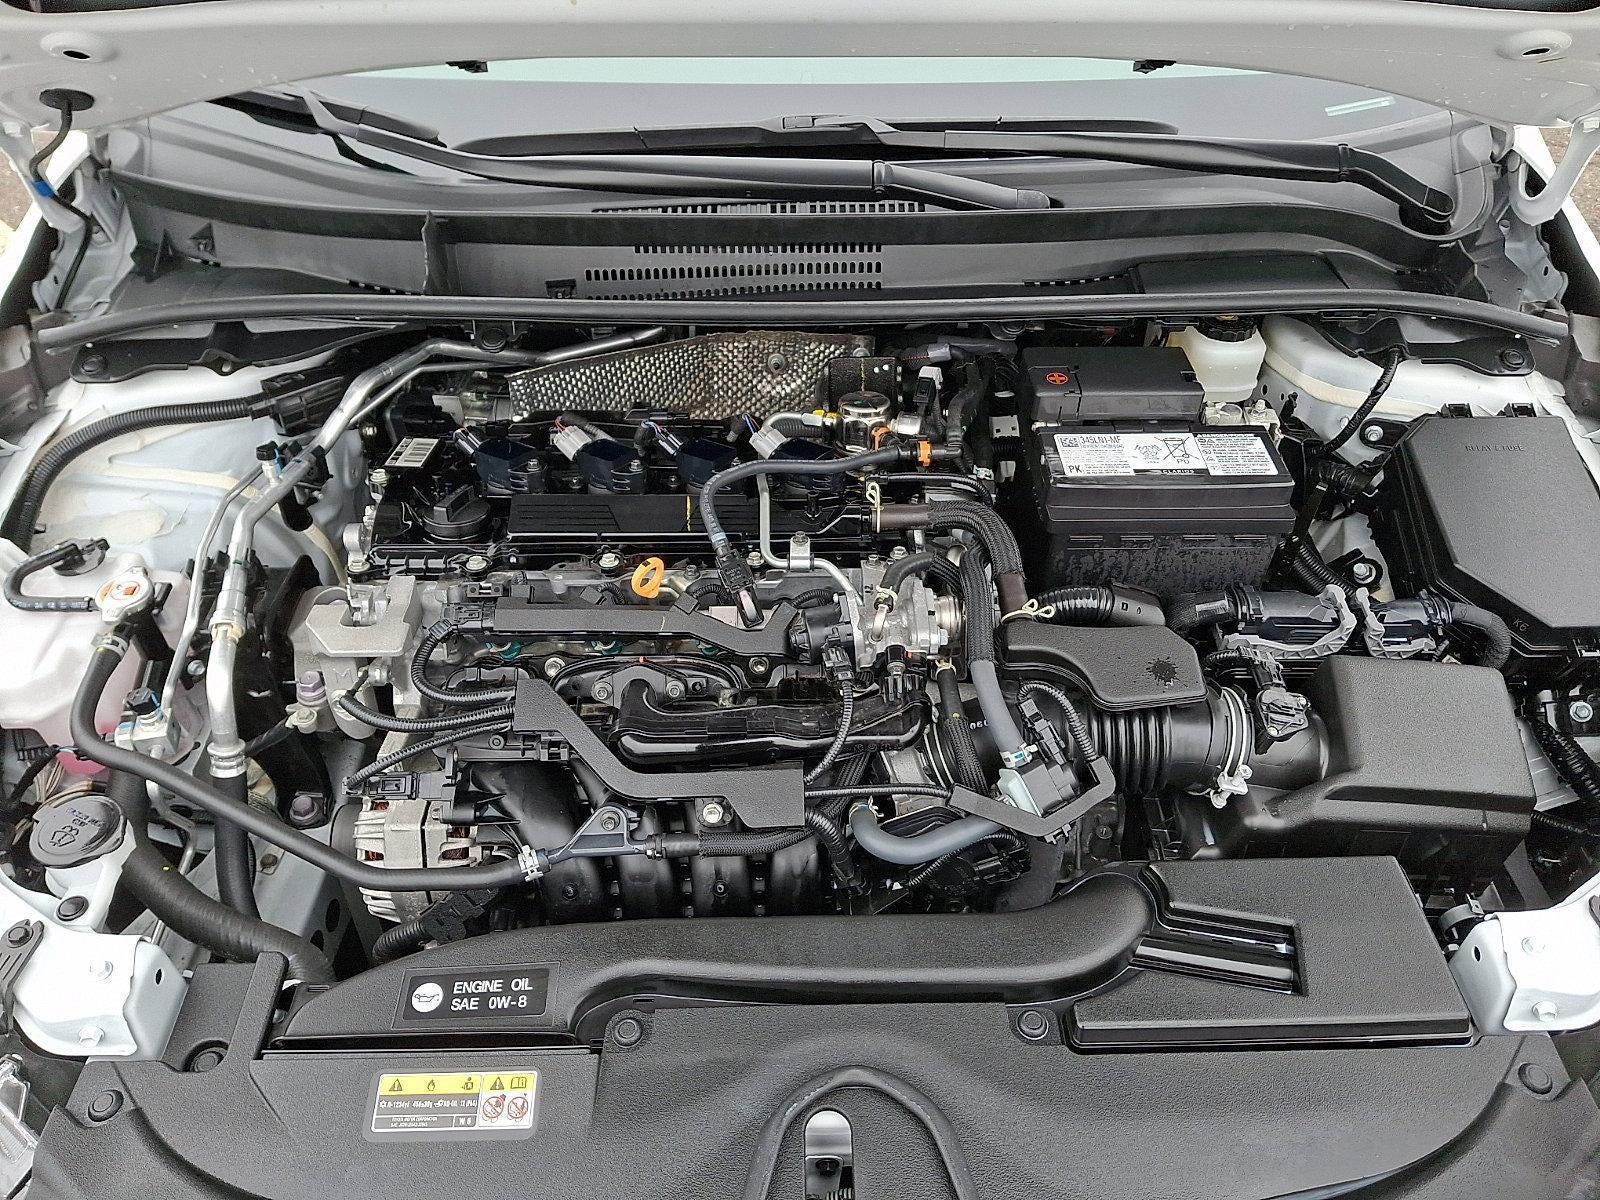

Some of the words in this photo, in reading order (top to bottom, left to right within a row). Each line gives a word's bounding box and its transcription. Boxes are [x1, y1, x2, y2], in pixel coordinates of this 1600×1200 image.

[1068, 464, 1083, 474] PK
[453, 979, 503, 994] ENGINE
[510, 977, 534, 991] OIL
[450, 997, 480, 1011] SAE
[488, 994, 528, 1010] 0W-8
